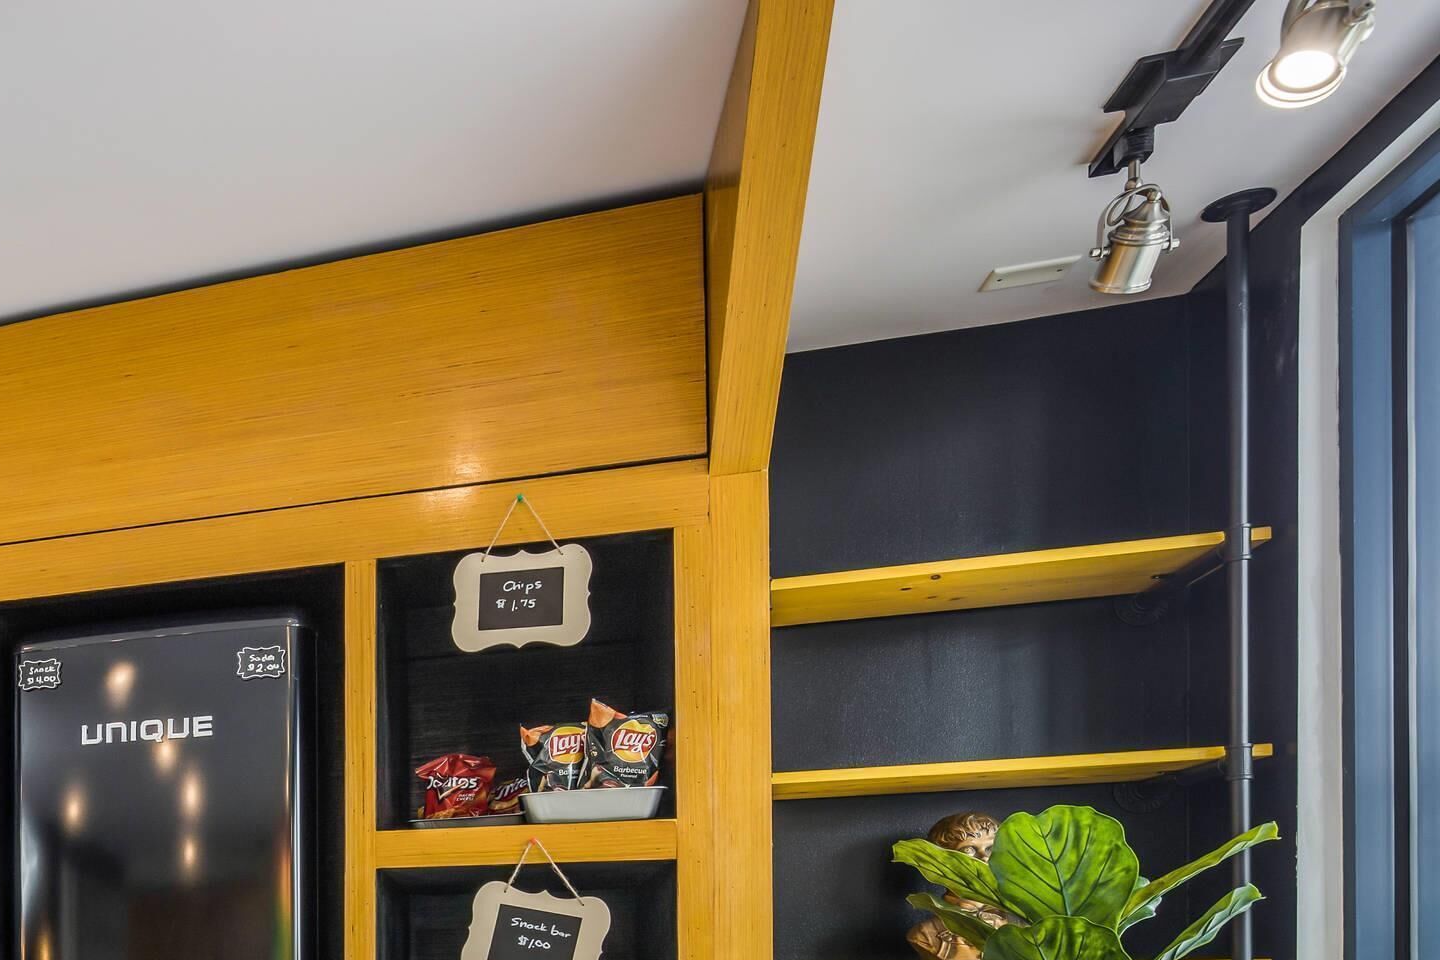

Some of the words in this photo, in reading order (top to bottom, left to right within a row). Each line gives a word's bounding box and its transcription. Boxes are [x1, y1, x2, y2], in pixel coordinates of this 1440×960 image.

[503, 579, 543, 595] Chips
[81, 715, 213, 745] UNIQUE
[615, 729, 656, 753] Lay's
[613, 765, 647, 775] Barbecue
[511, 917, 548, 932] Snack
[550, 924, 572, 939] bar
